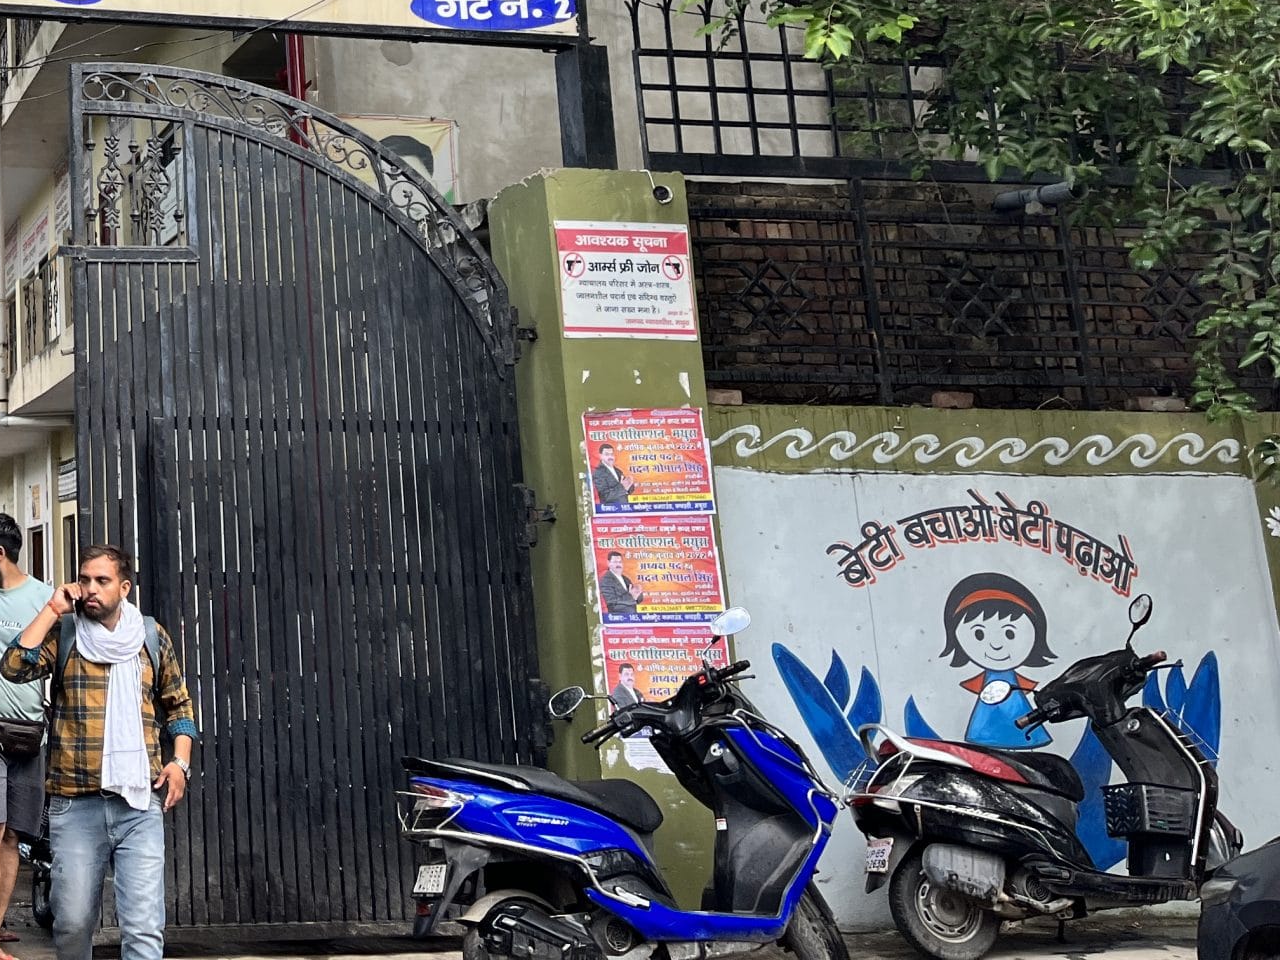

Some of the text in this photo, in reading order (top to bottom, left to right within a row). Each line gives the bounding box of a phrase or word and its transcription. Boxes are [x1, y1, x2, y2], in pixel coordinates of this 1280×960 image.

[575, 234, 668, 253] आवश्यक सूचना
[588, 257, 660, 274] आर्म्स फ्री जोन
[825, 488, 1139, 597] बेटी बचाओ बेटी पढ़ाओ
